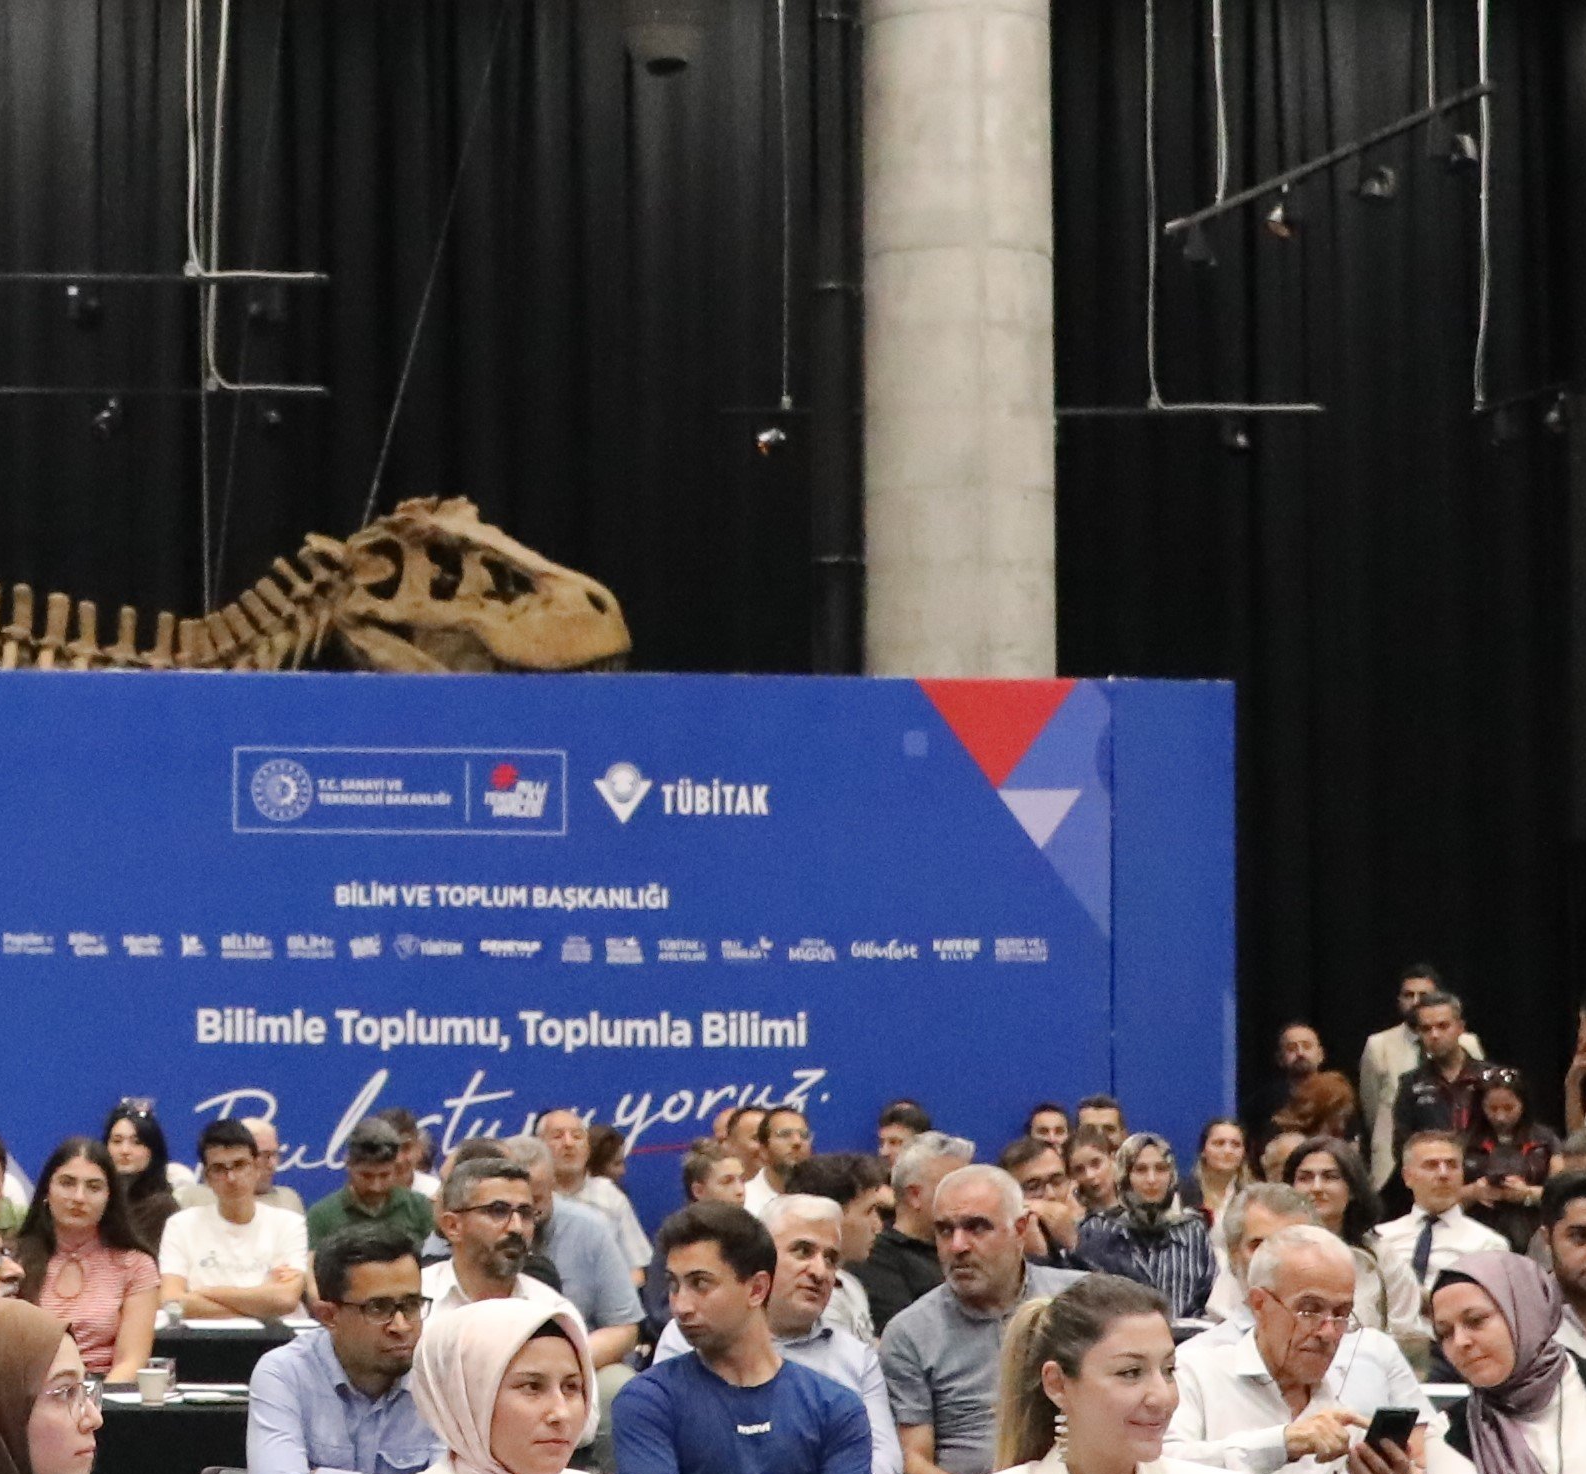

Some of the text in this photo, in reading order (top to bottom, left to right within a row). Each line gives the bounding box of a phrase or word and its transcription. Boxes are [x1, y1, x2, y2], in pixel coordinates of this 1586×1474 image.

[661, 780, 769, 816] TÜBİTAK
[335, 881, 671, 913] BİLİM VE TOPLUM BAŞKANLIĞI
[196, 1008, 808, 1053] Bilimle Toplumu, Toplumla Bilimi
